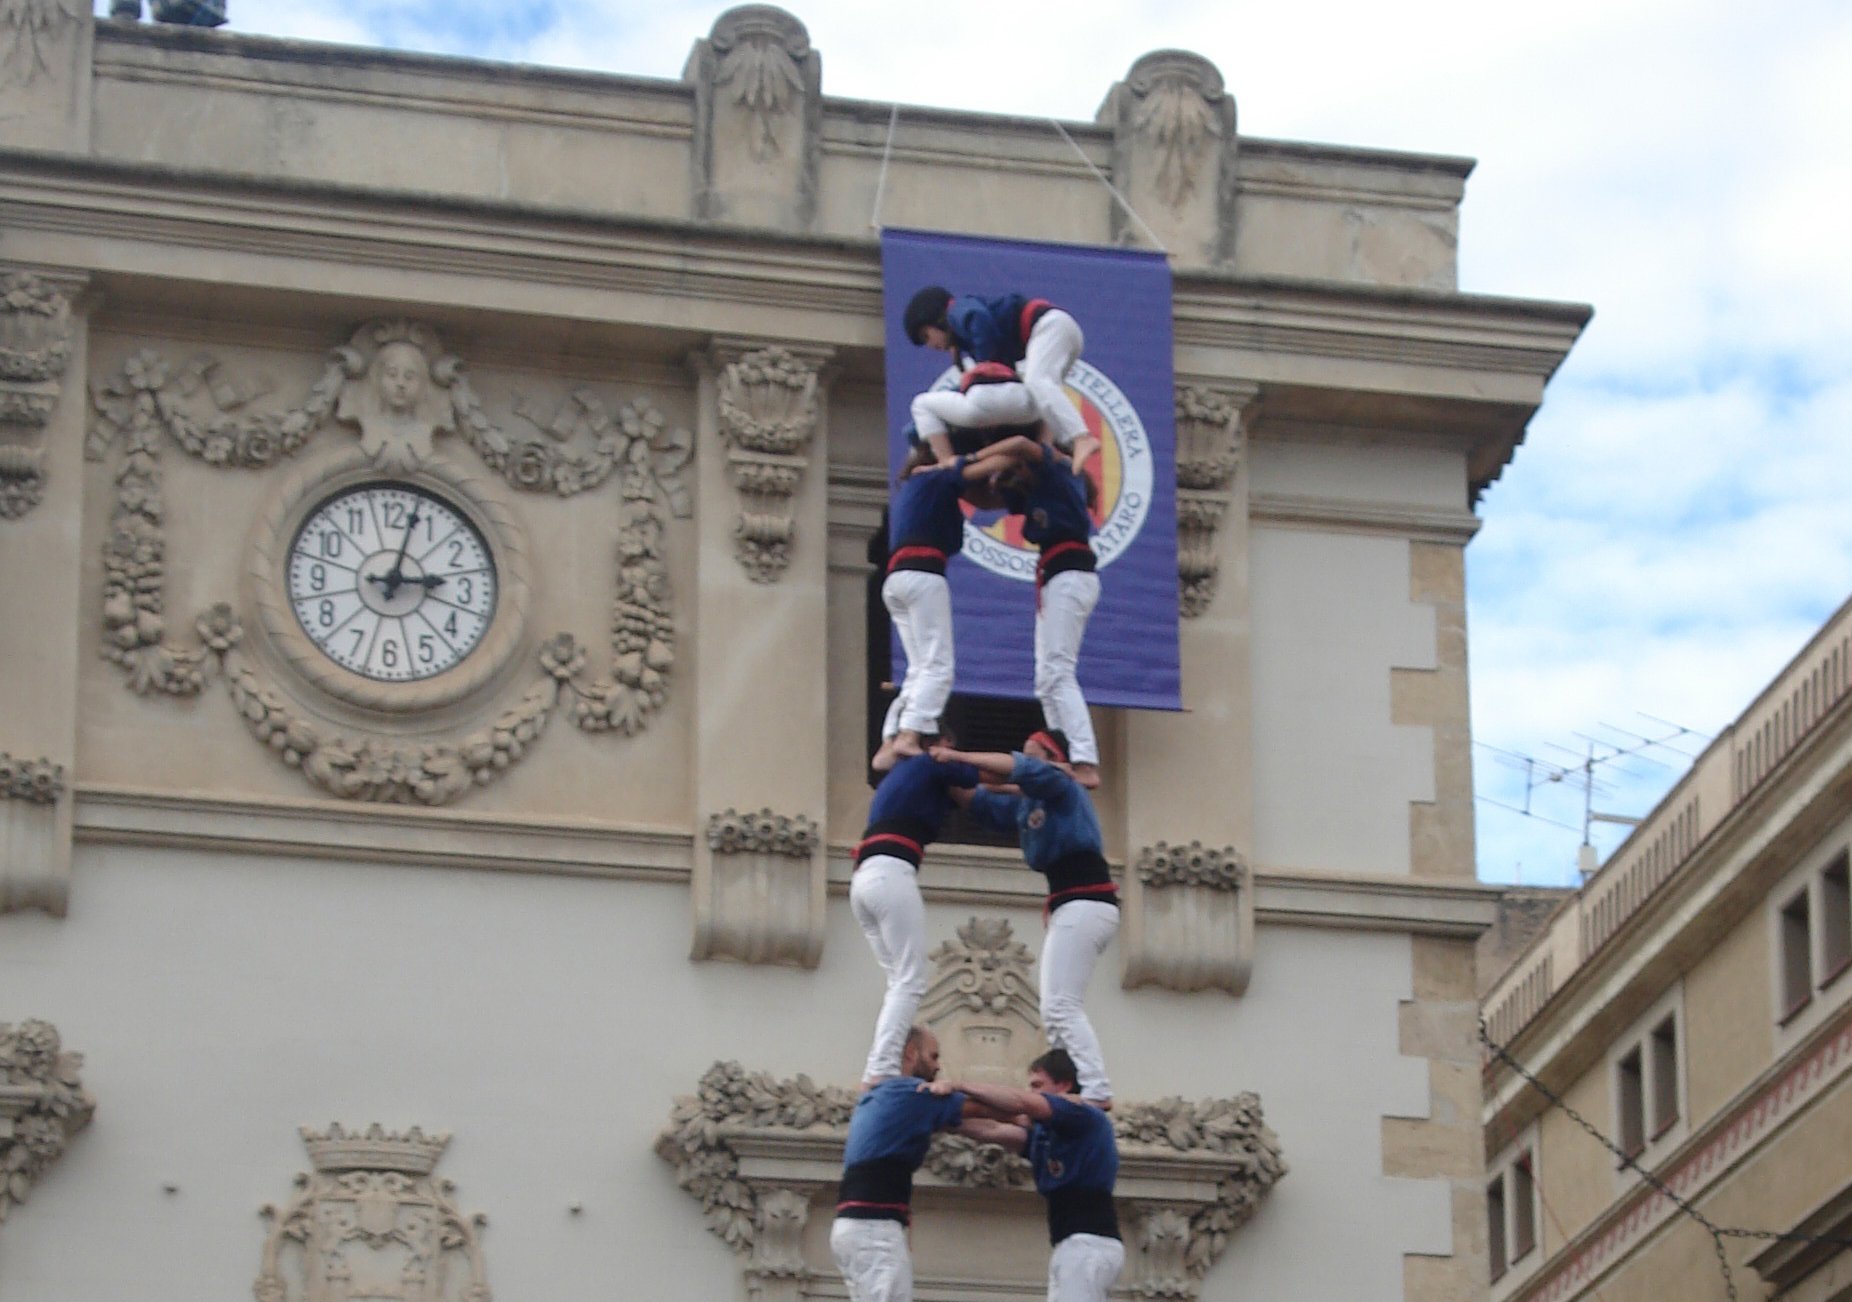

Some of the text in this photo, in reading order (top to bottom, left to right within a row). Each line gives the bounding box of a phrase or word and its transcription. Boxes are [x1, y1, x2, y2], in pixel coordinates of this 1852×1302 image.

[1066, 364, 1143, 458] STELLERA
[347, 507, 363, 535] 11
[381, 502, 405, 530] 12
[425, 514, 433, 542] 1
[1096, 491, 1141, 557] ATARO
[318, 530, 341, 558] 10
[448, 540, 464, 568] 2
[963, 528, 1037, 575] OSSOS
[310, 564, 325, 591] 9
[457, 577, 472, 604] 3
[319, 600, 334, 627] 8
[444, 610, 458, 638] 4
[350, 629, 364, 657] 7
[382, 639, 397, 667] 6
[419, 635, 433, 663] 5
